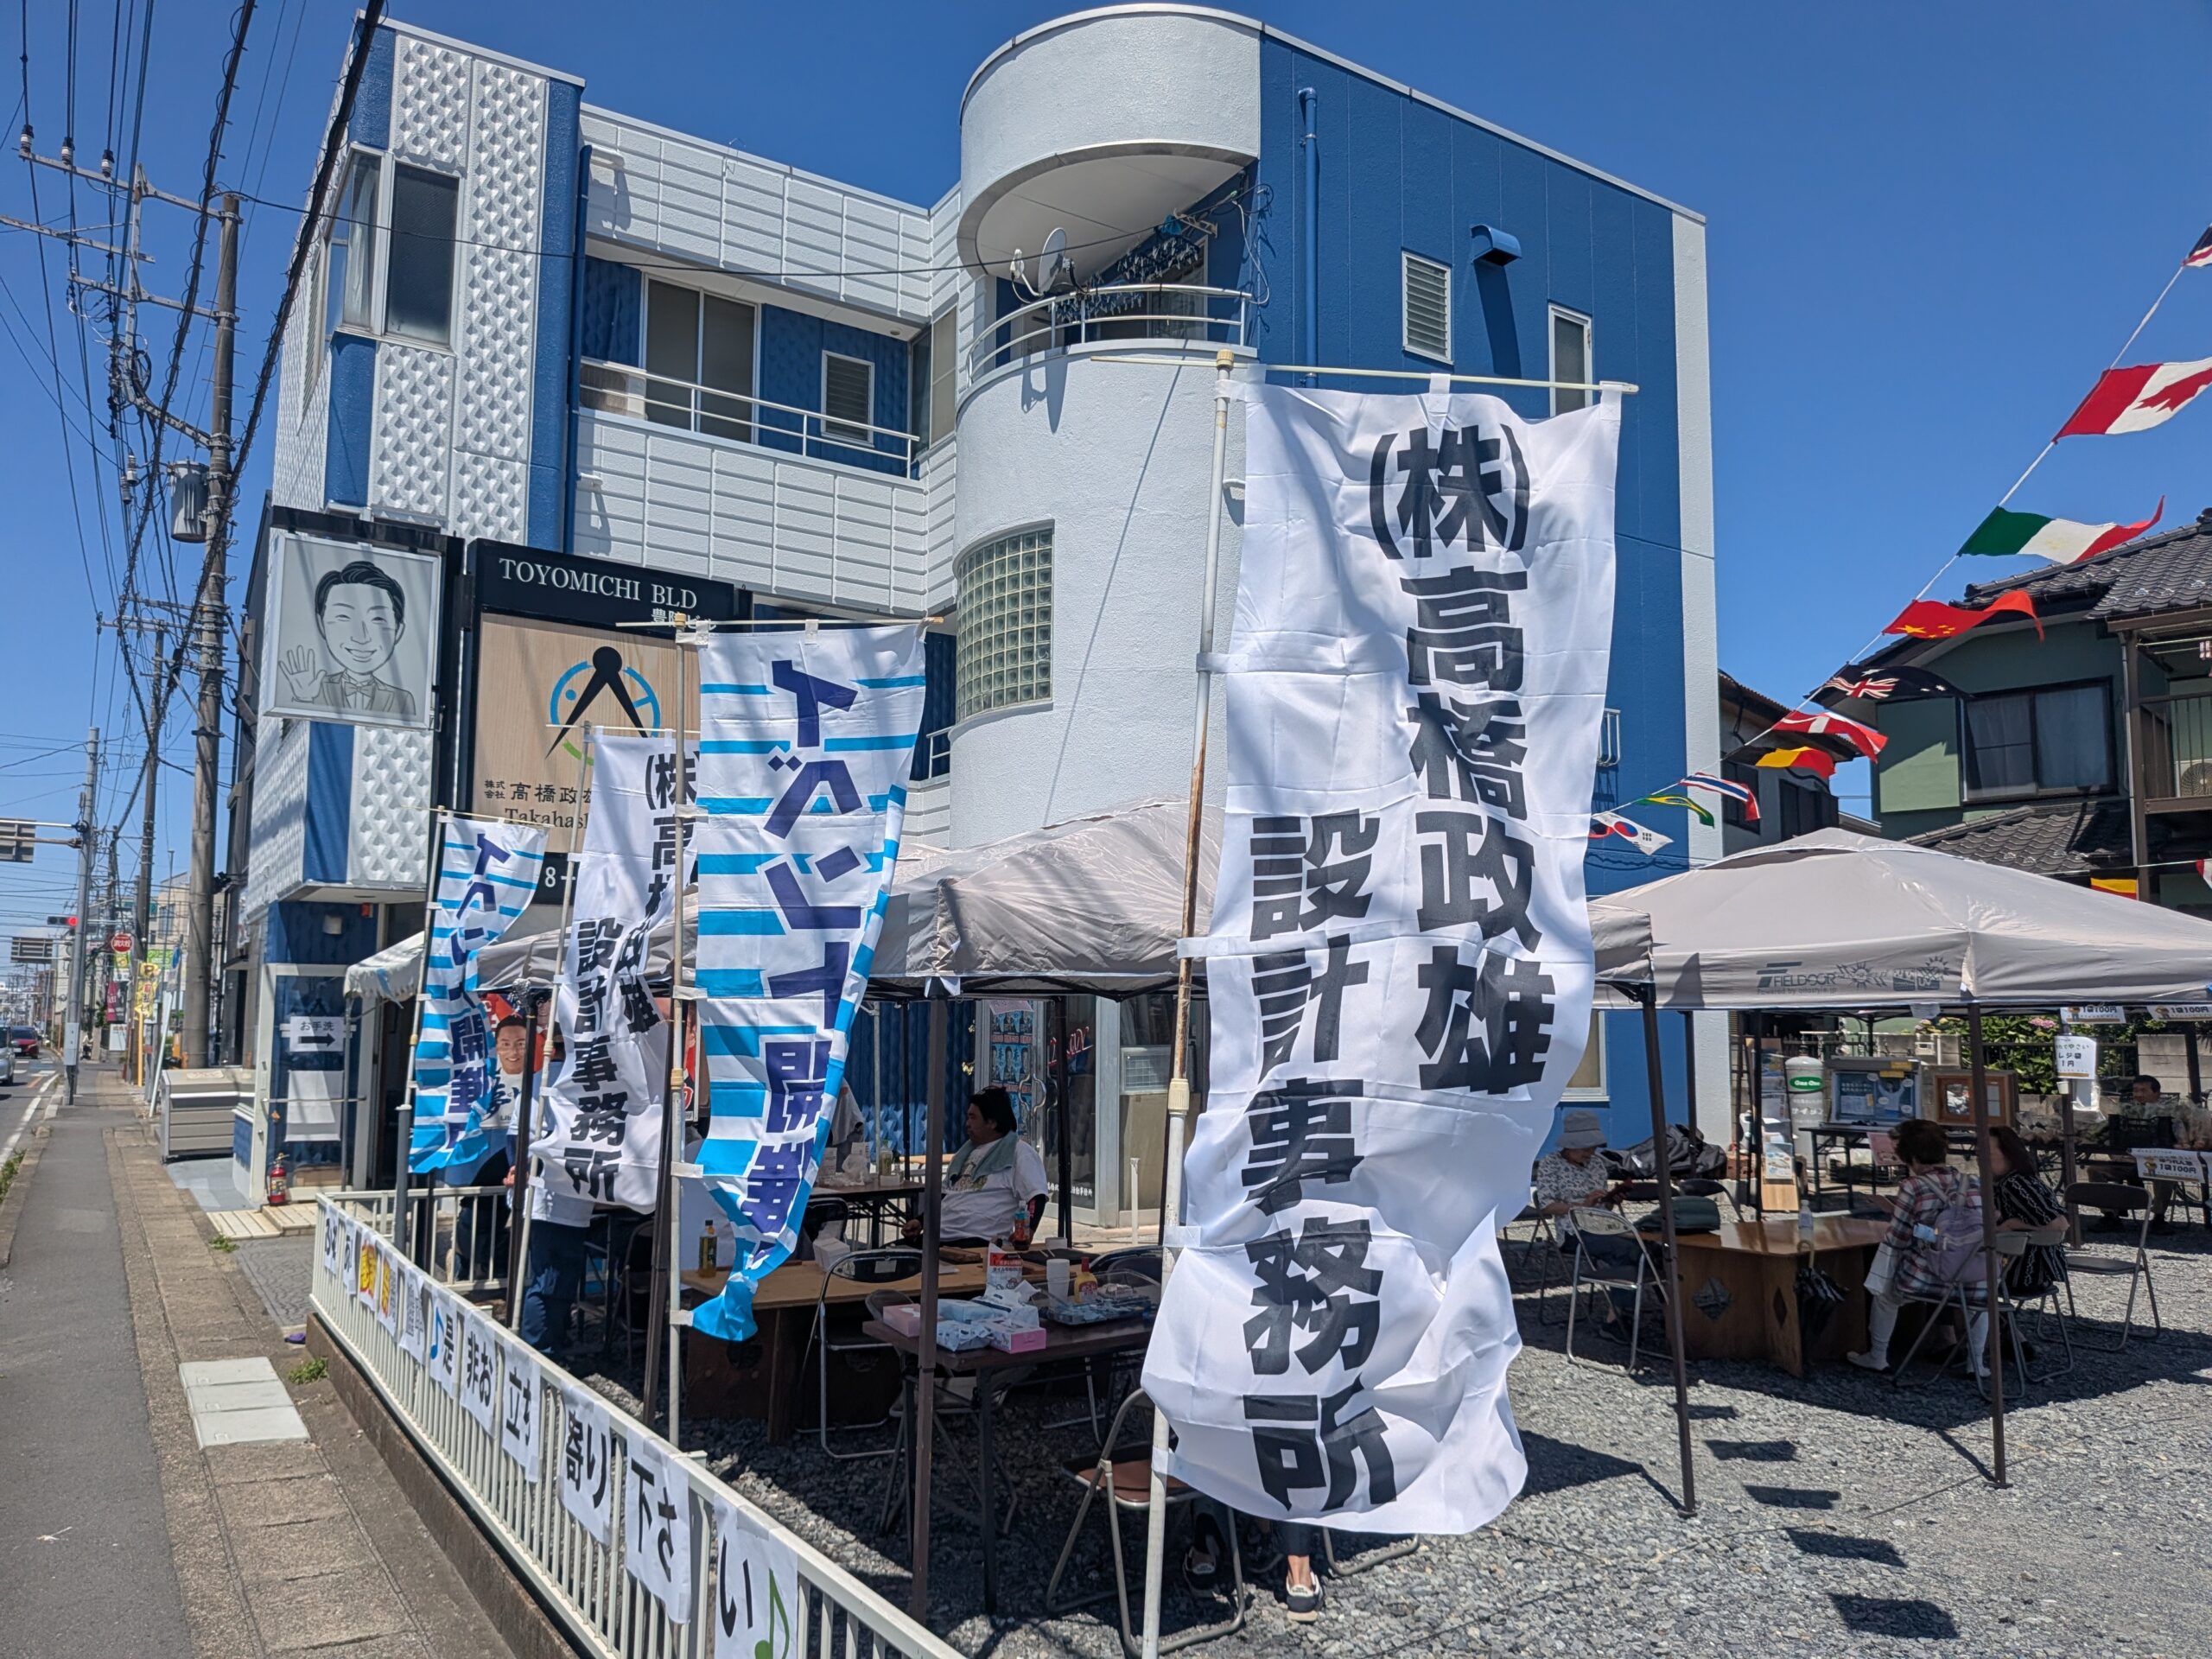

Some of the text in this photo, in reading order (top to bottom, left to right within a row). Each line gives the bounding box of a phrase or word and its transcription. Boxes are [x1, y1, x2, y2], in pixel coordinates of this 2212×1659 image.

[499, 557, 697, 609] TOYOMICHI BLD
[651, 607, 717, 631] 豊ビル
[1370, 423, 1555, 1096] (株)高橋政雄
[299, 1020, 334, 1032] お手洗
[563, 917, 629, 1203] 設計事務所
[1242, 807, 1399, 1517] 設計事務所
